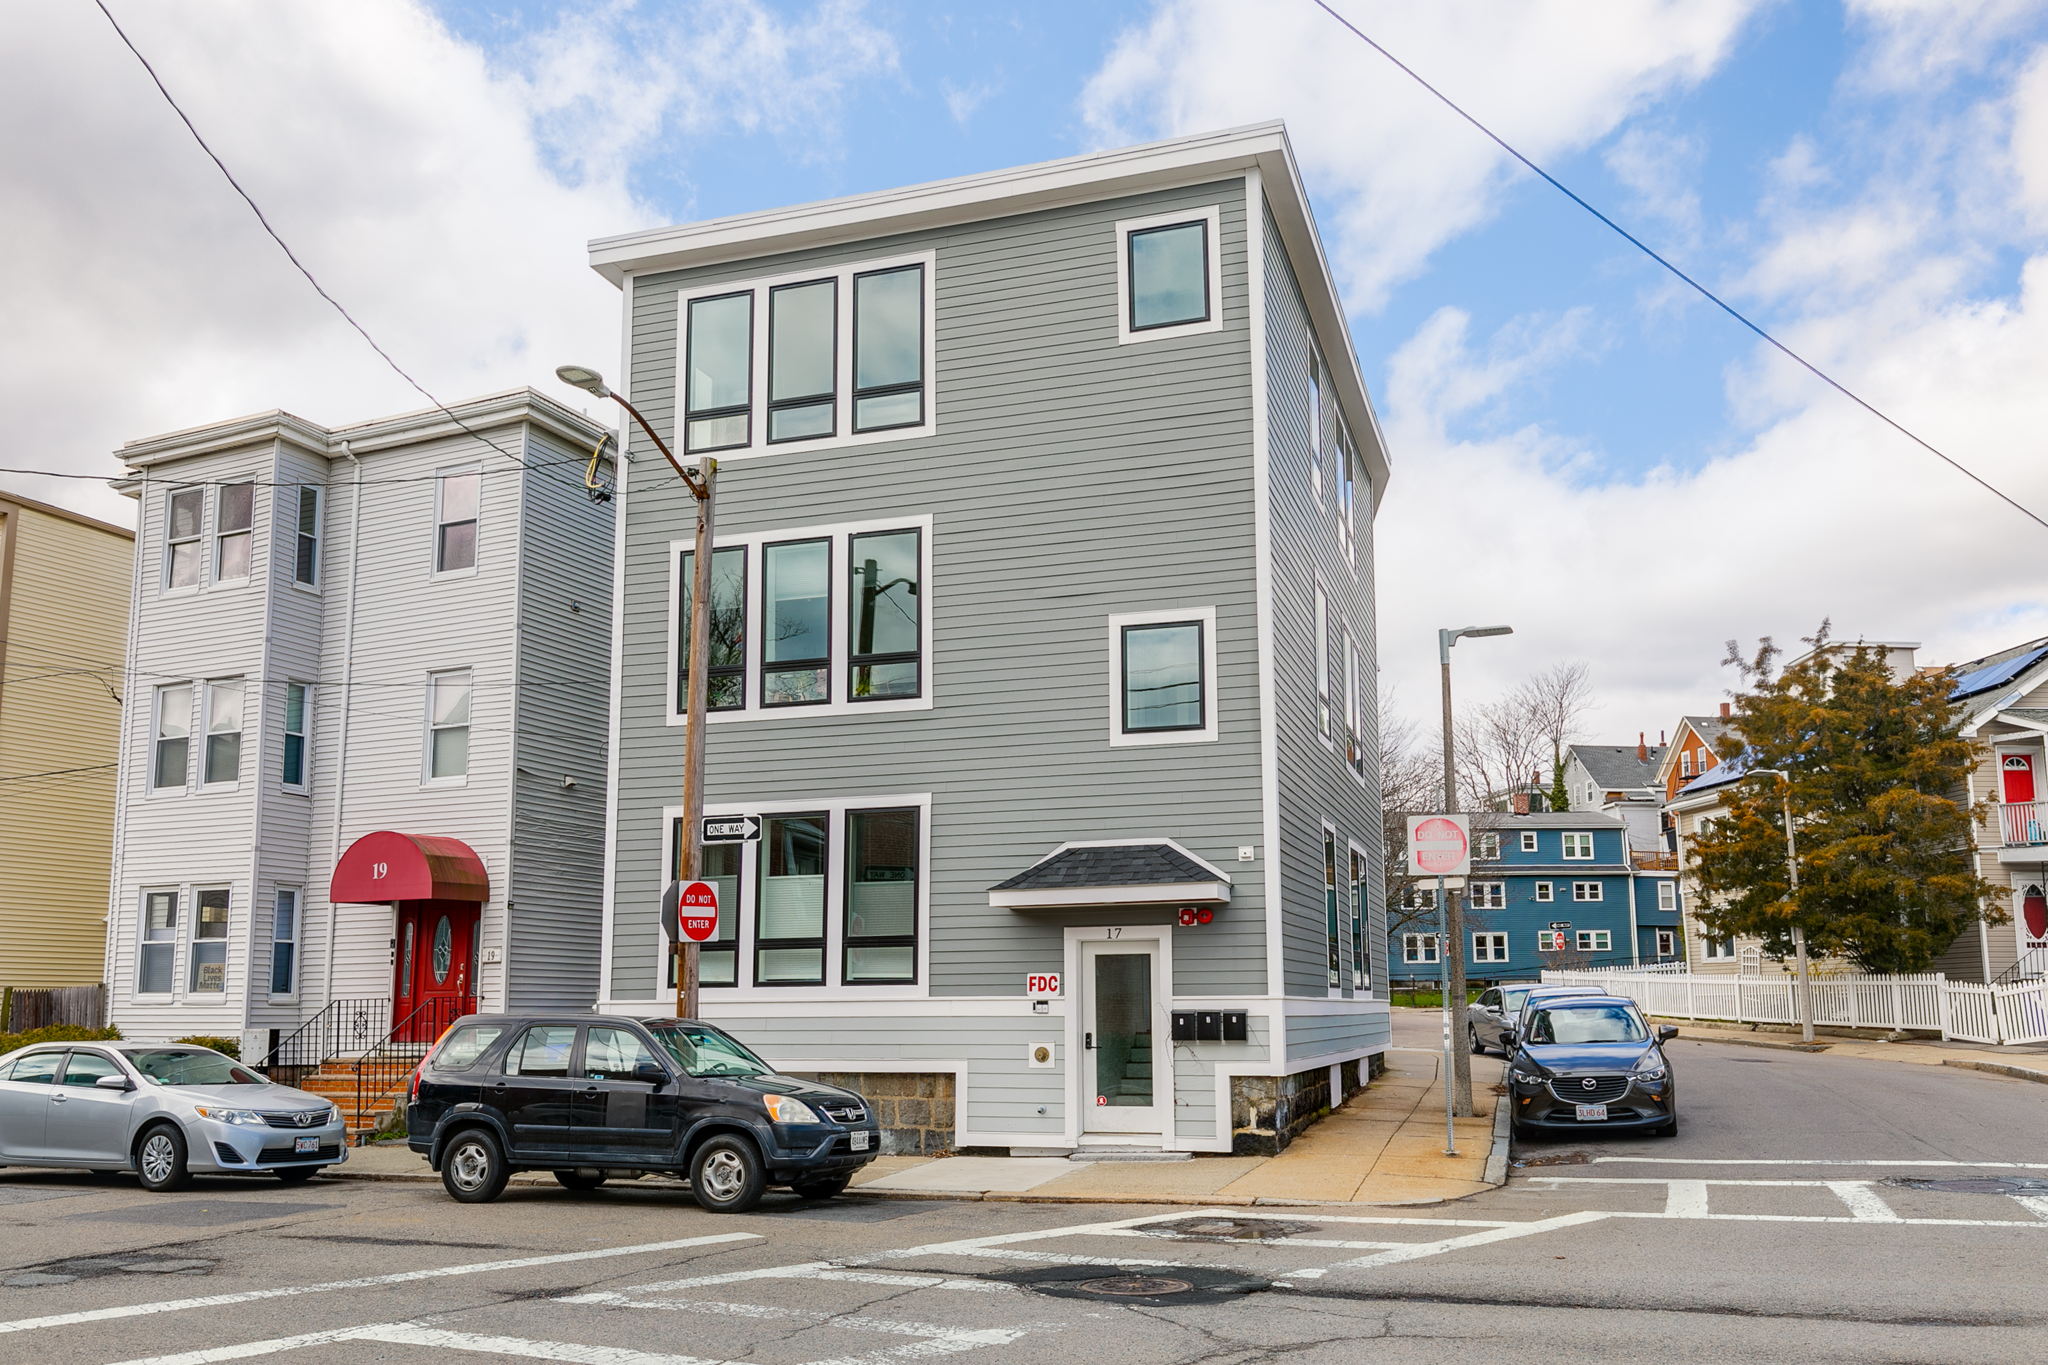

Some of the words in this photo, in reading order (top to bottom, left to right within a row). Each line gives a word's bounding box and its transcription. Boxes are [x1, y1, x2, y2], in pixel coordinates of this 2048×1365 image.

[708, 824, 724, 835] ONE
[729, 823, 744, 833] WAY
[1418, 830, 1432, 839] DO
[372, 862, 388, 880] 19
[686, 894, 696, 904] DO
[698, 894, 712, 904] NOT
[687, 919, 710, 929] ENTER
[1106, 928, 1122, 940] 17
[487, 950, 496, 961] 19
[203, 966, 223, 974] Black
[1028, 975, 1058, 992] FDC
